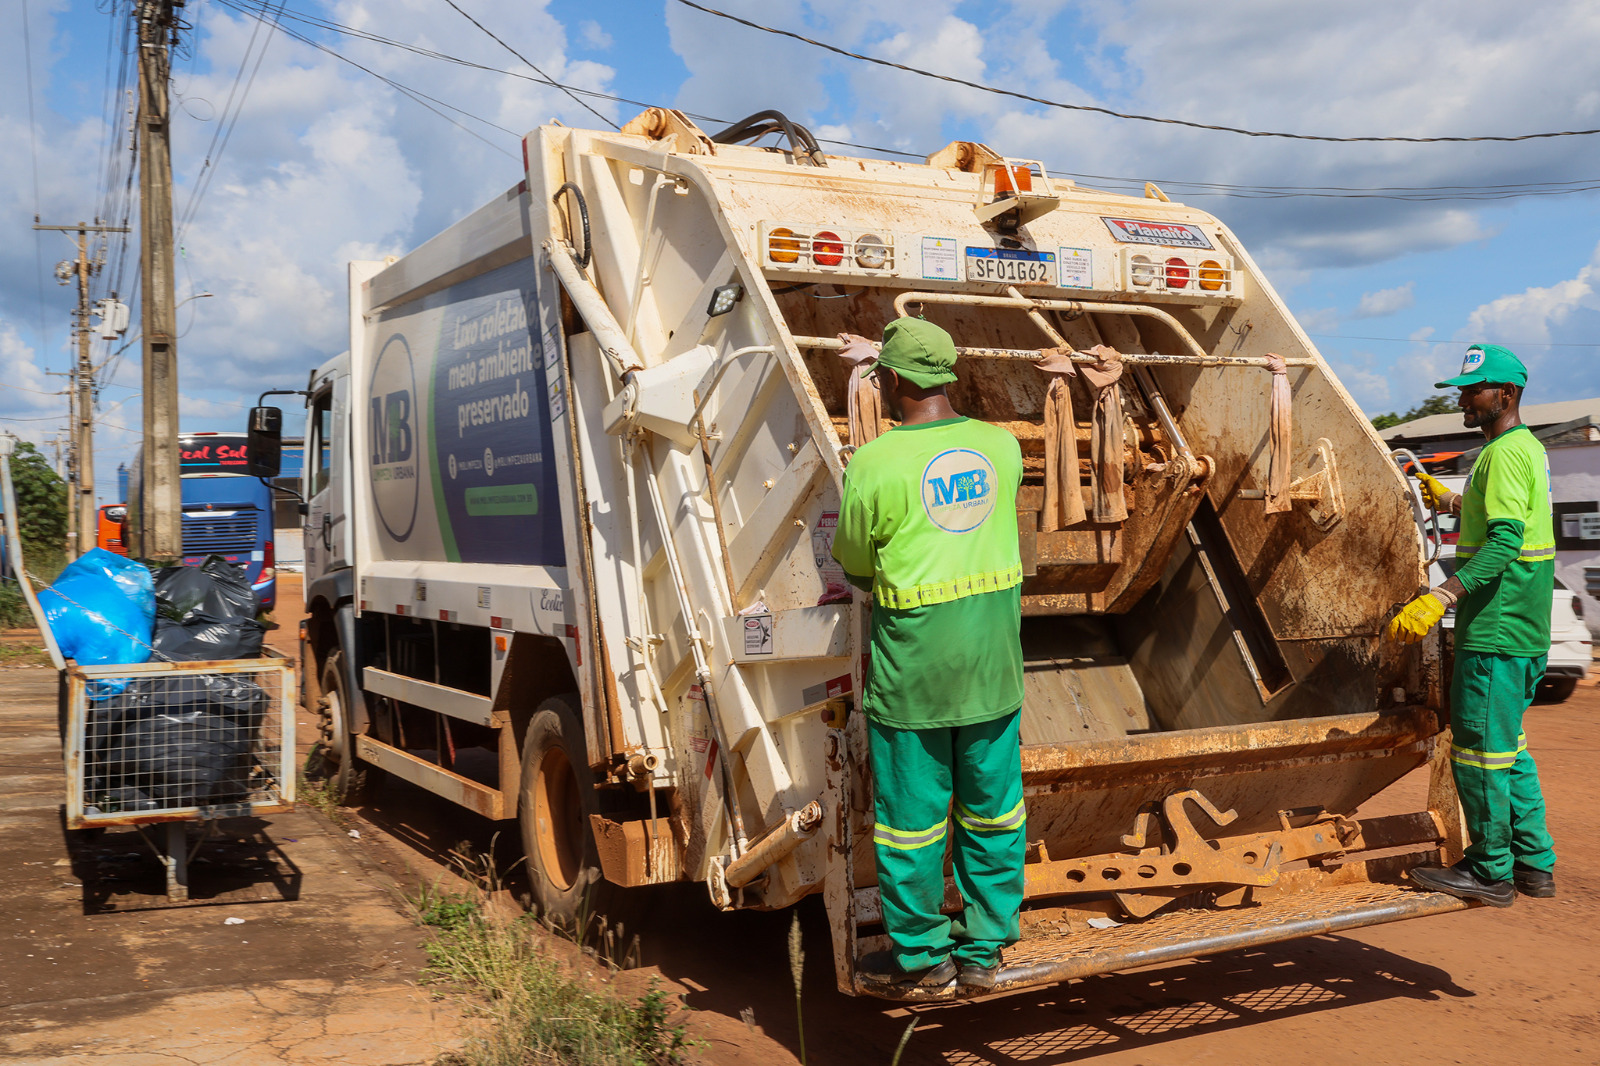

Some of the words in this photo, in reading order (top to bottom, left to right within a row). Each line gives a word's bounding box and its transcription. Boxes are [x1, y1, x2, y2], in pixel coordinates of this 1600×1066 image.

[454, 315, 479, 350] Lixo
[448, 352, 476, 390] meio
[478, 335, 542, 384] ambiente
[372, 389, 412, 465] MB
[458, 379, 529, 438] preservado
[179, 445, 210, 459] eal
[215, 445, 248, 459] Sul
[927, 469, 991, 508] MB
[821, 518, 838, 527] PERIG
